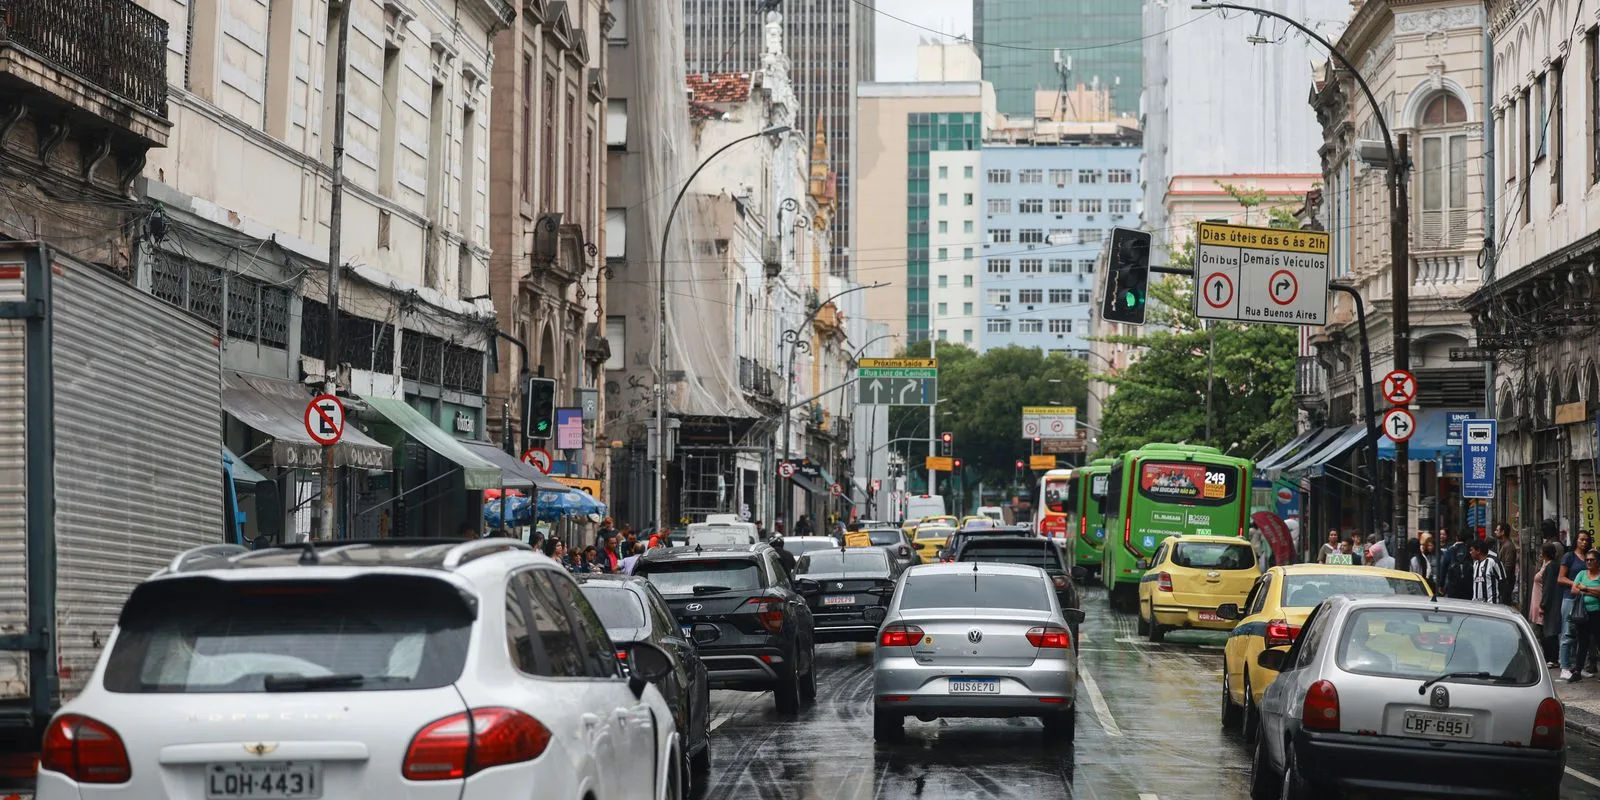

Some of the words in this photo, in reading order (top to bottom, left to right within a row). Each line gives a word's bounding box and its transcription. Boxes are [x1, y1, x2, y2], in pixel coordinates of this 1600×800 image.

[1202, 228, 1226, 241] Dias
[1230, 231, 1257, 244] úteis
[1260, 233, 1279, 246] das
[1282, 236, 1290, 246] 6
[1308, 237, 1325, 249] 21h
[1201, 251, 1238, 266] Ônibus
[1243, 252, 1280, 266] Demais
[1283, 255, 1325, 269] Veículos
[1245, 306, 1261, 317] Rua
[1264, 307, 1293, 319] Buenos
[1295, 309, 1317, 320] Aires
[873, 359, 902, 367] Próxima
[320, 405, 335, 434] E
[1204, 471, 1226, 485] 249
[1327, 554, 1352, 565] TAXI
